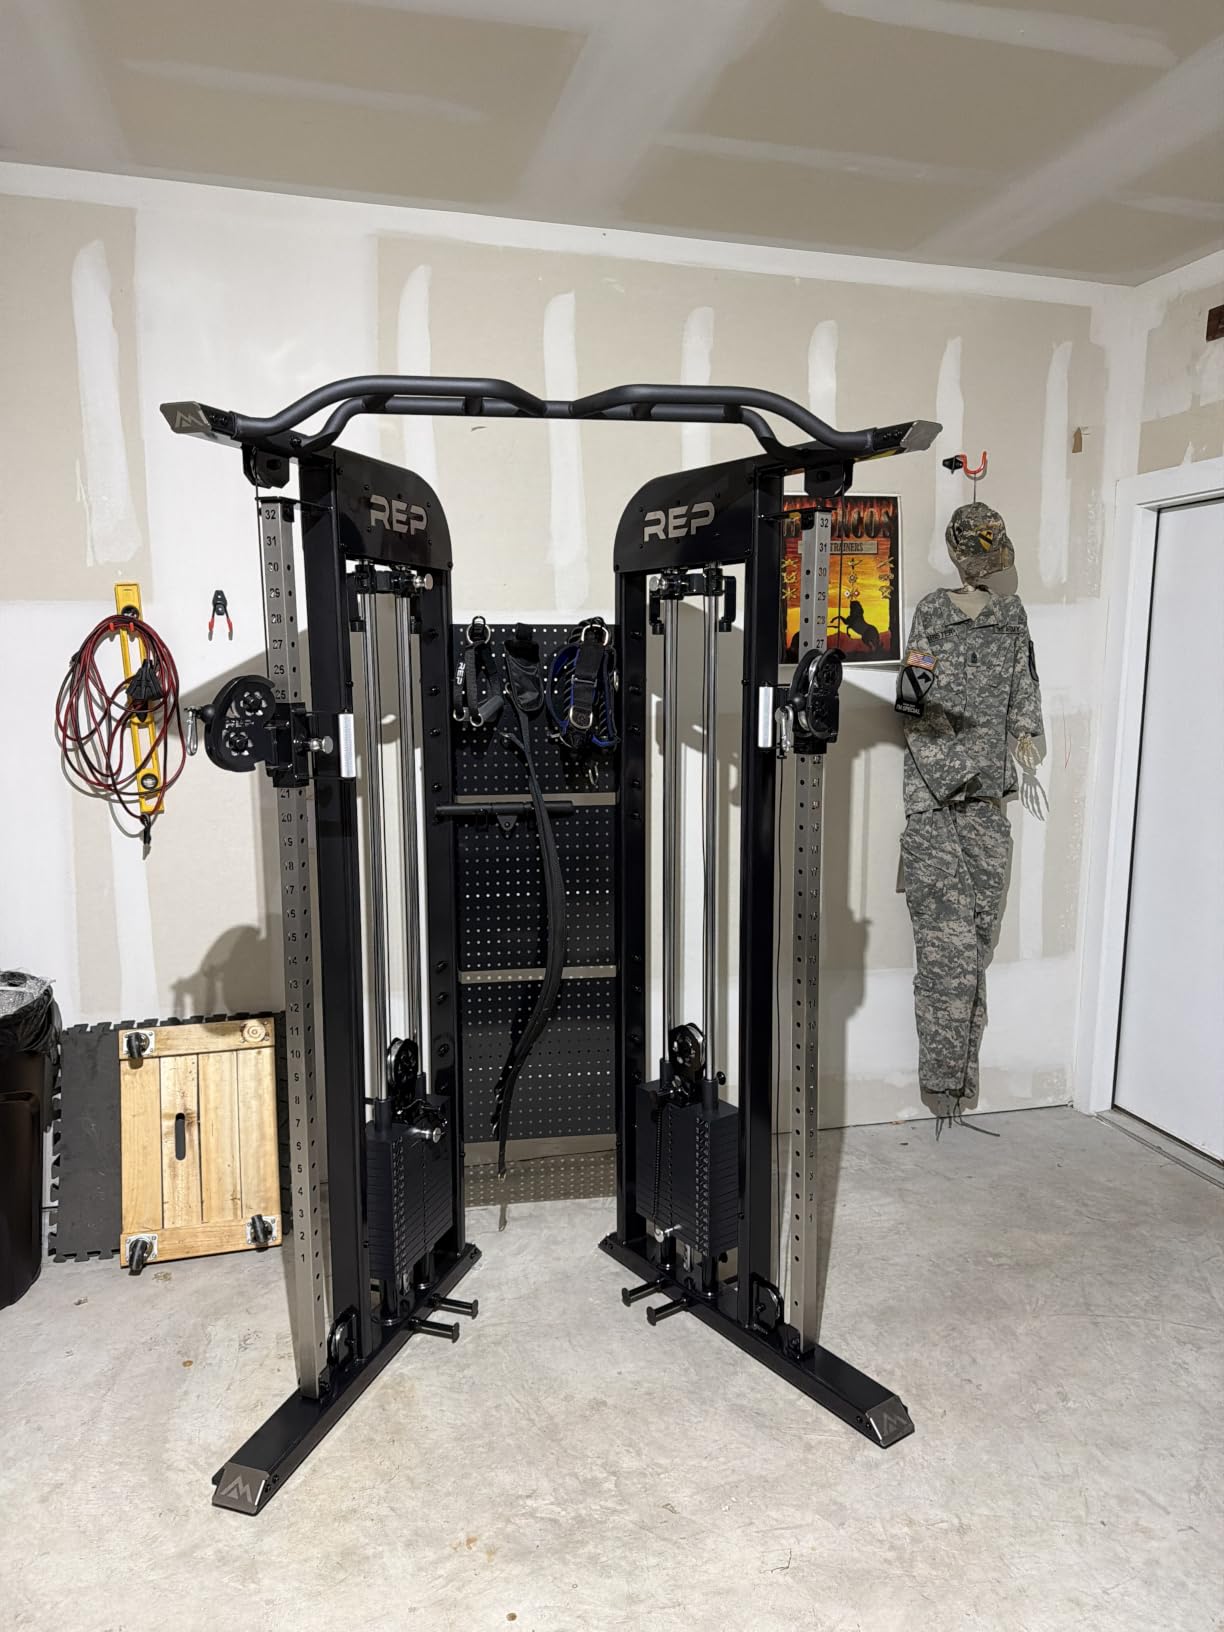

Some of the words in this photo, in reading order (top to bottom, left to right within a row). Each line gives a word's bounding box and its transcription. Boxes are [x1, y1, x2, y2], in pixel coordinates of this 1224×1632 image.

[264, 508, 277, 520] 32
[369, 494, 428, 536] REP
[642, 501, 716, 543] REP
[820, 518, 830, 529] 32
[266, 536, 278, 547] 31
[819, 542, 828, 553] 31
[268, 562, 280, 573] 30
[818, 567, 828, 578] 30
[271, 613, 282, 624] 28
[272, 639, 284, 650] 27
[816, 639, 825, 649] 27
[455, 662, 466, 685] REP
[275, 689, 287, 700] 25
[281, 813, 292, 823] 20
[290, 1027, 299, 1036] 11
[291, 1050, 301, 1059] 10
[295, 1118, 301, 1128] 7
[297, 1164, 303, 1174] 5
[297, 1186, 303, 1196] 4
[298, 1208, 304, 1218] 3
[299, 1231, 305, 1241] 2
